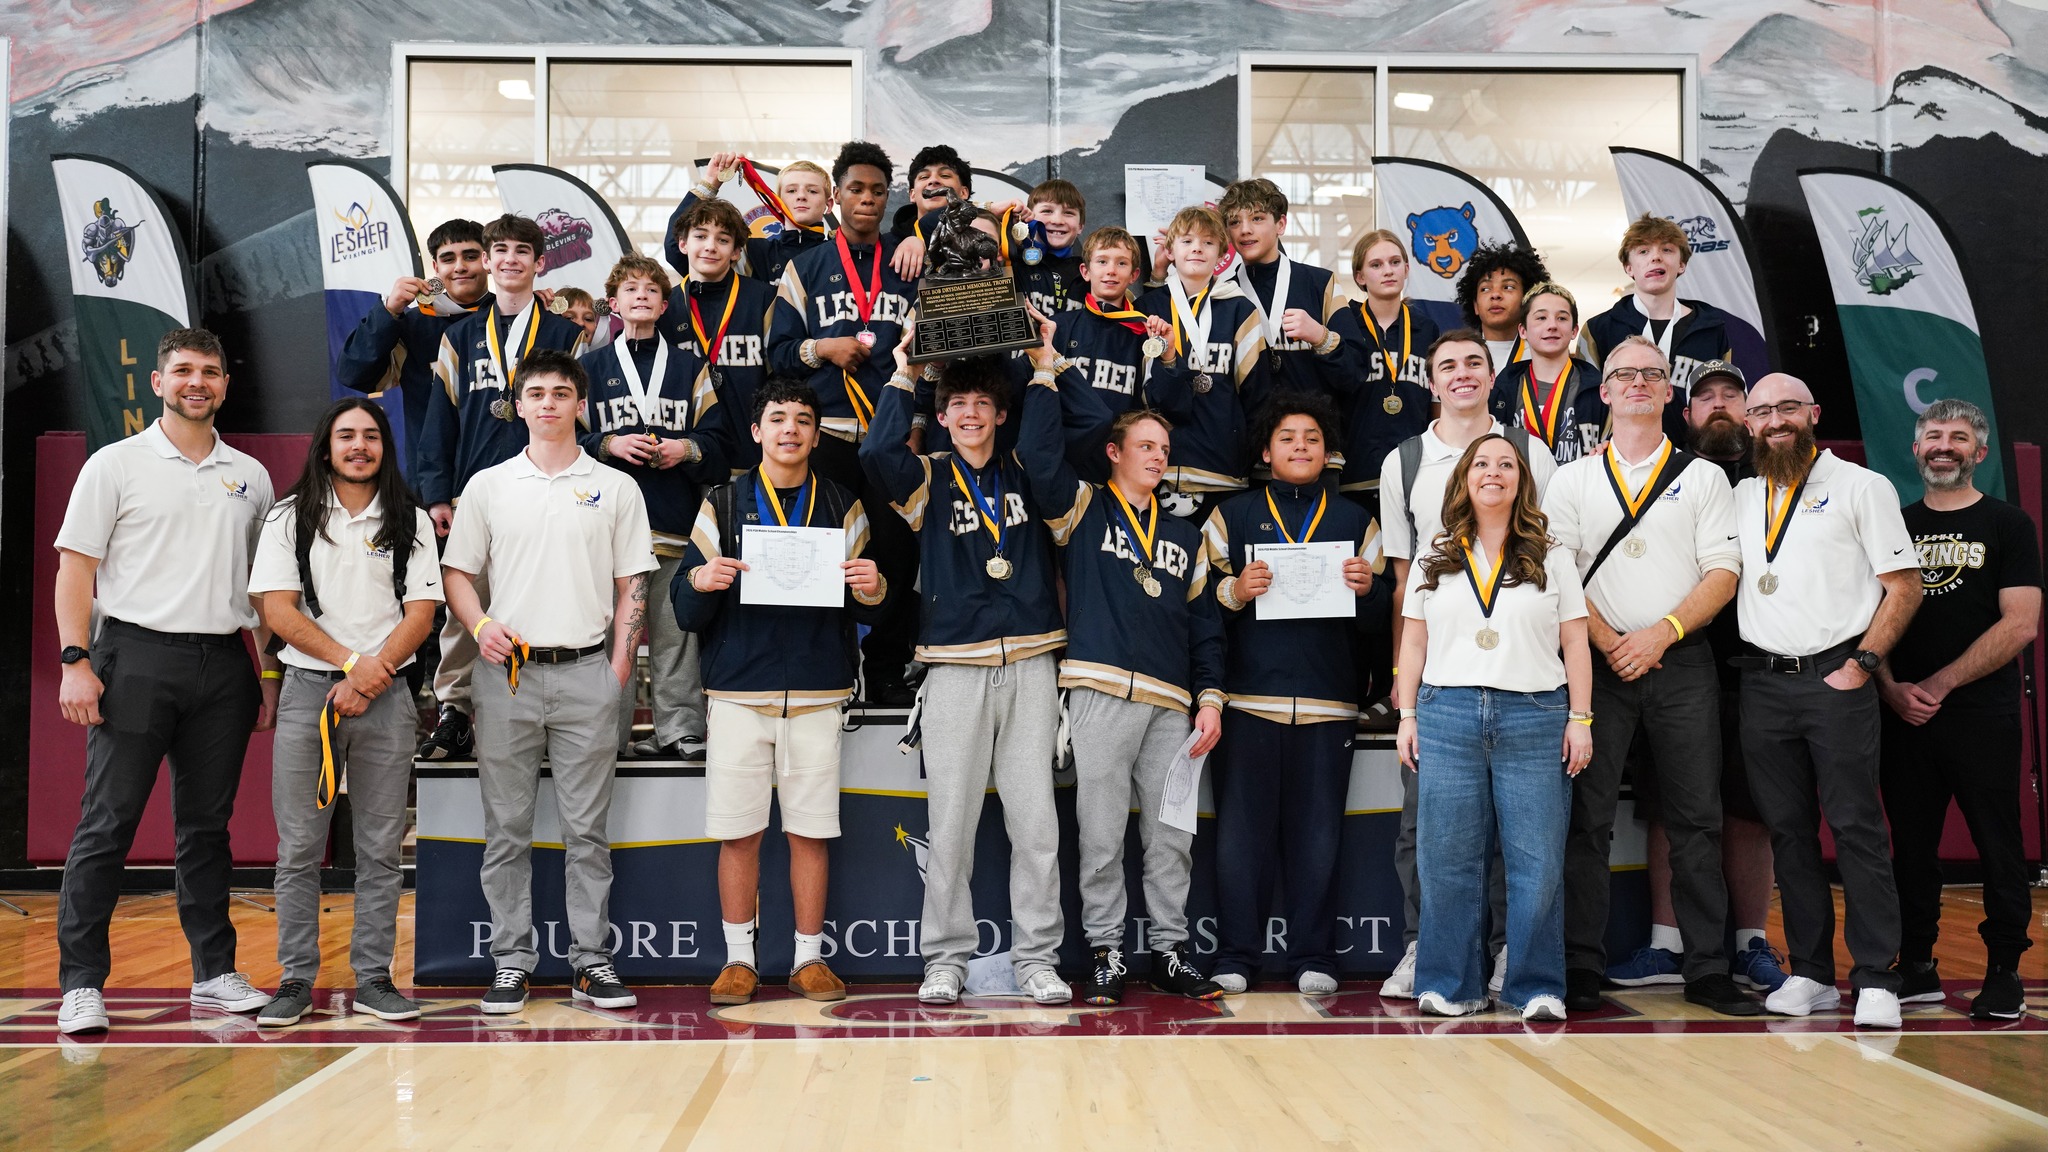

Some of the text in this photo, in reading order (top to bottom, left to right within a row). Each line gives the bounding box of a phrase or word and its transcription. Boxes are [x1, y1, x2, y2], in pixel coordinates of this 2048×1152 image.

[331, 221, 388, 263] LESHER
[546, 234, 576, 251] BLEVINS
[1689, 240, 1731, 254] mas
[343, 247, 376, 260] VIKINGS
[941, 285, 966, 294] DRYSDALE
[966, 281, 992, 290] MEMORIAL
[1903, 367, 1938, 415] C
[1915, 533, 1963, 542] LESHER
[366, 550, 391, 559] LESHER
[1913, 541, 1986, 570] KINGS
[1923, 578, 1963, 596] STLING
[820, 918, 1014, 958] SCHO
